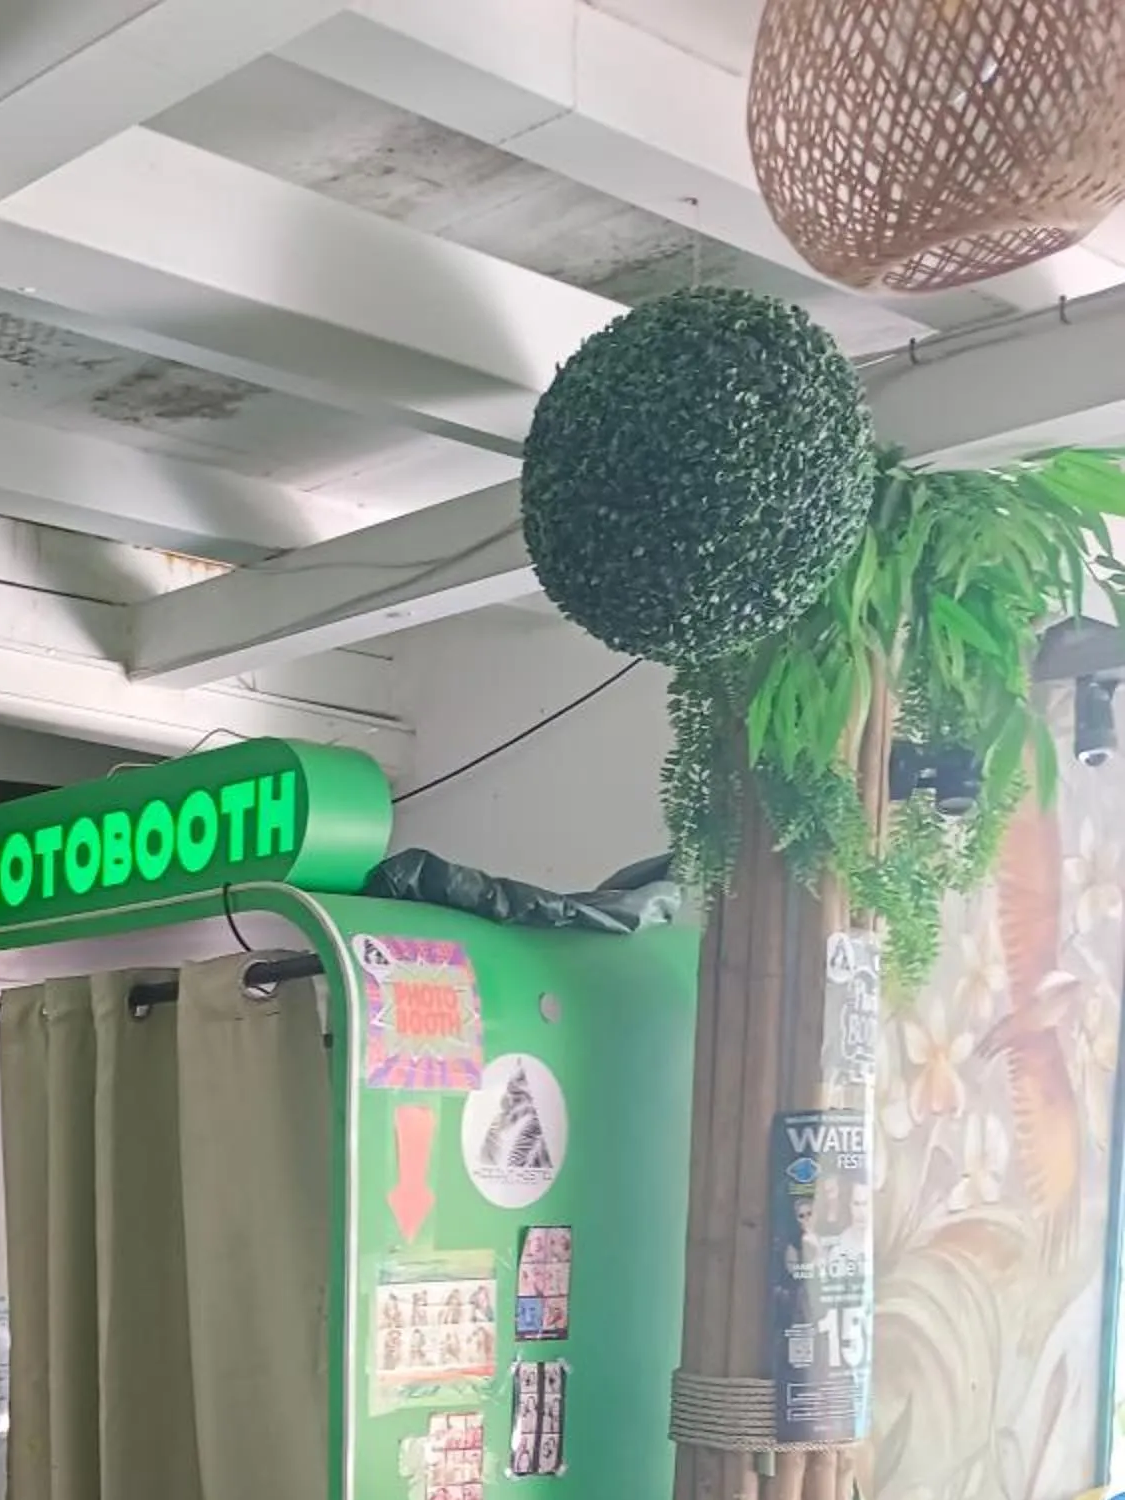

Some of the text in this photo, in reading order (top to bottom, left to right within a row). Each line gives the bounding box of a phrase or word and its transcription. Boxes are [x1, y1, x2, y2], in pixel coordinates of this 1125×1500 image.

[393, 981, 459, 1008] PHOTO
[395, 1008, 462, 1036] BOOTH
[786, 1125, 868, 1153] WATE
